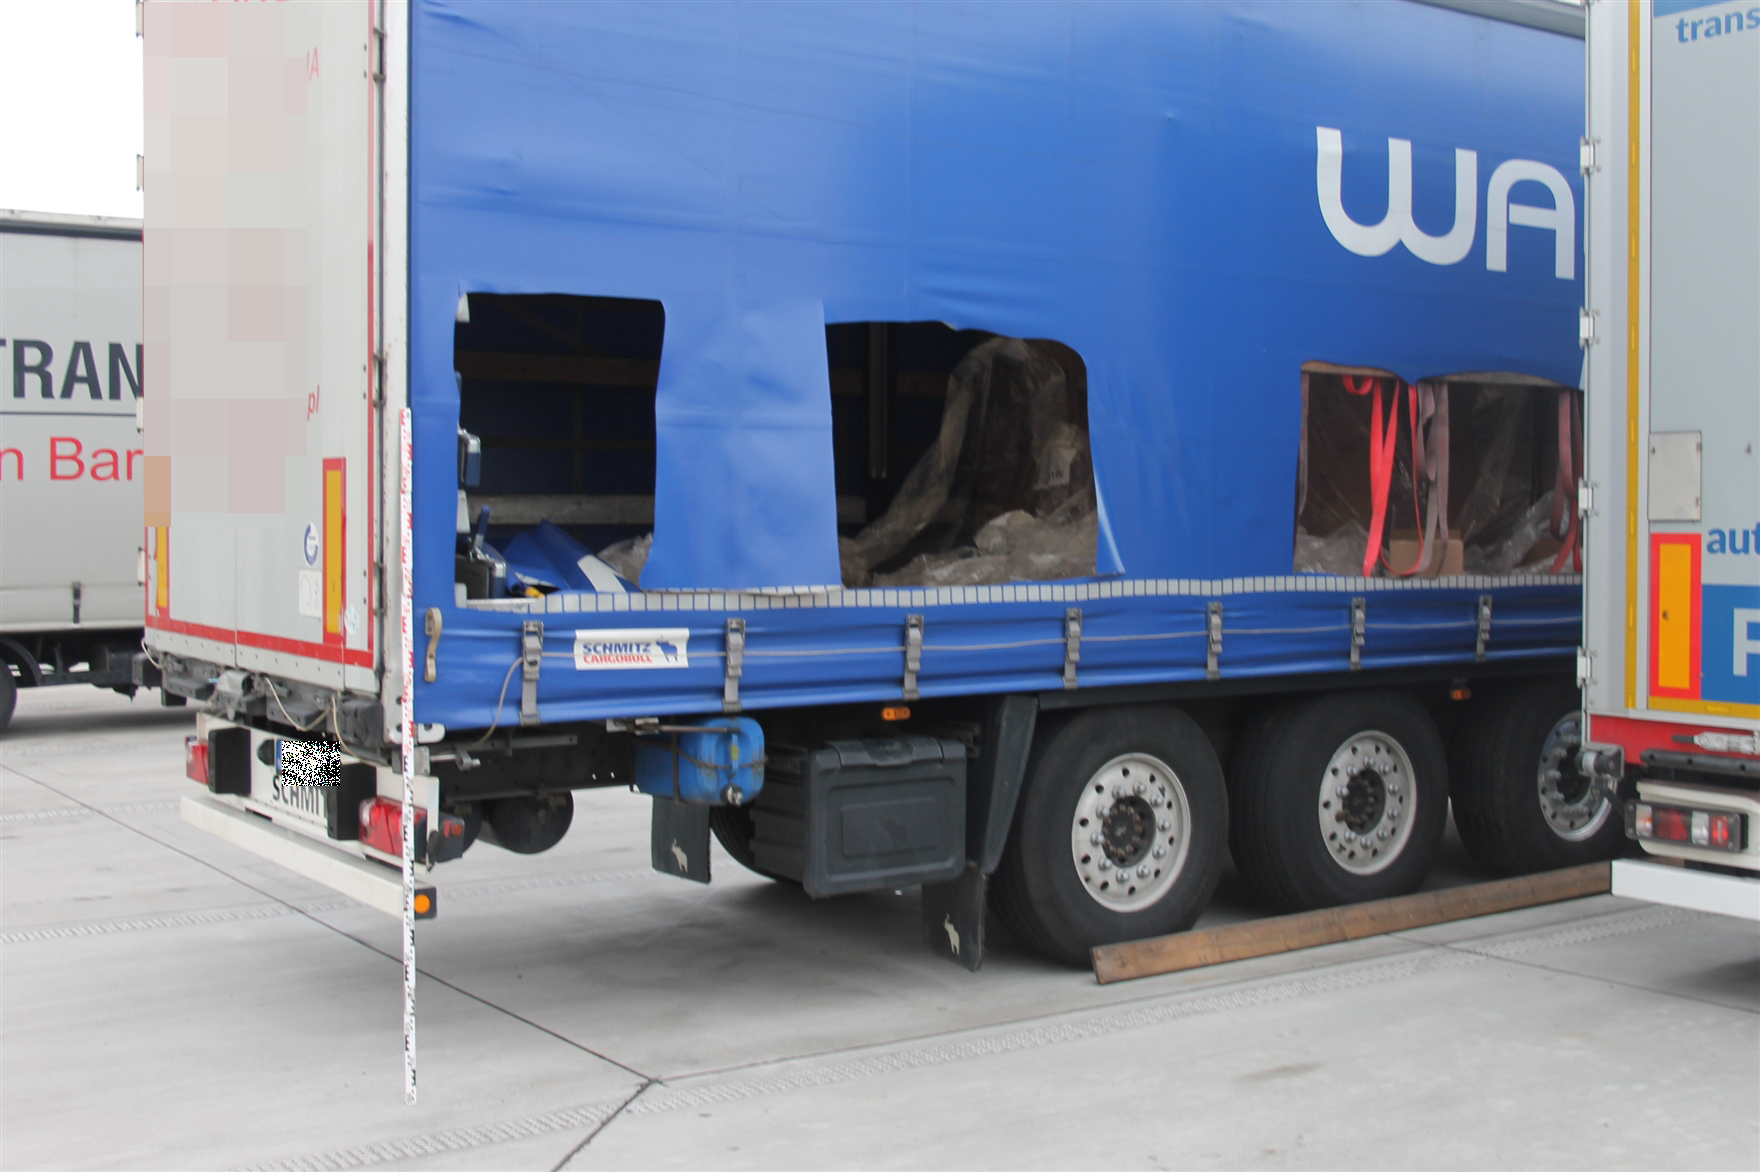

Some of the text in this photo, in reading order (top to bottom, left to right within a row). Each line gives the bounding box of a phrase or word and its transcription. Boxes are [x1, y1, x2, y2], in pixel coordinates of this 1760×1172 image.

[1675, 7, 1760, 44] trans
[0, 338, 144, 401] RAN
[582, 642, 652, 654] SCHMITZ
[582, 653, 653, 665] CARGOBULL
[272, 774, 328, 819] SCHMI
